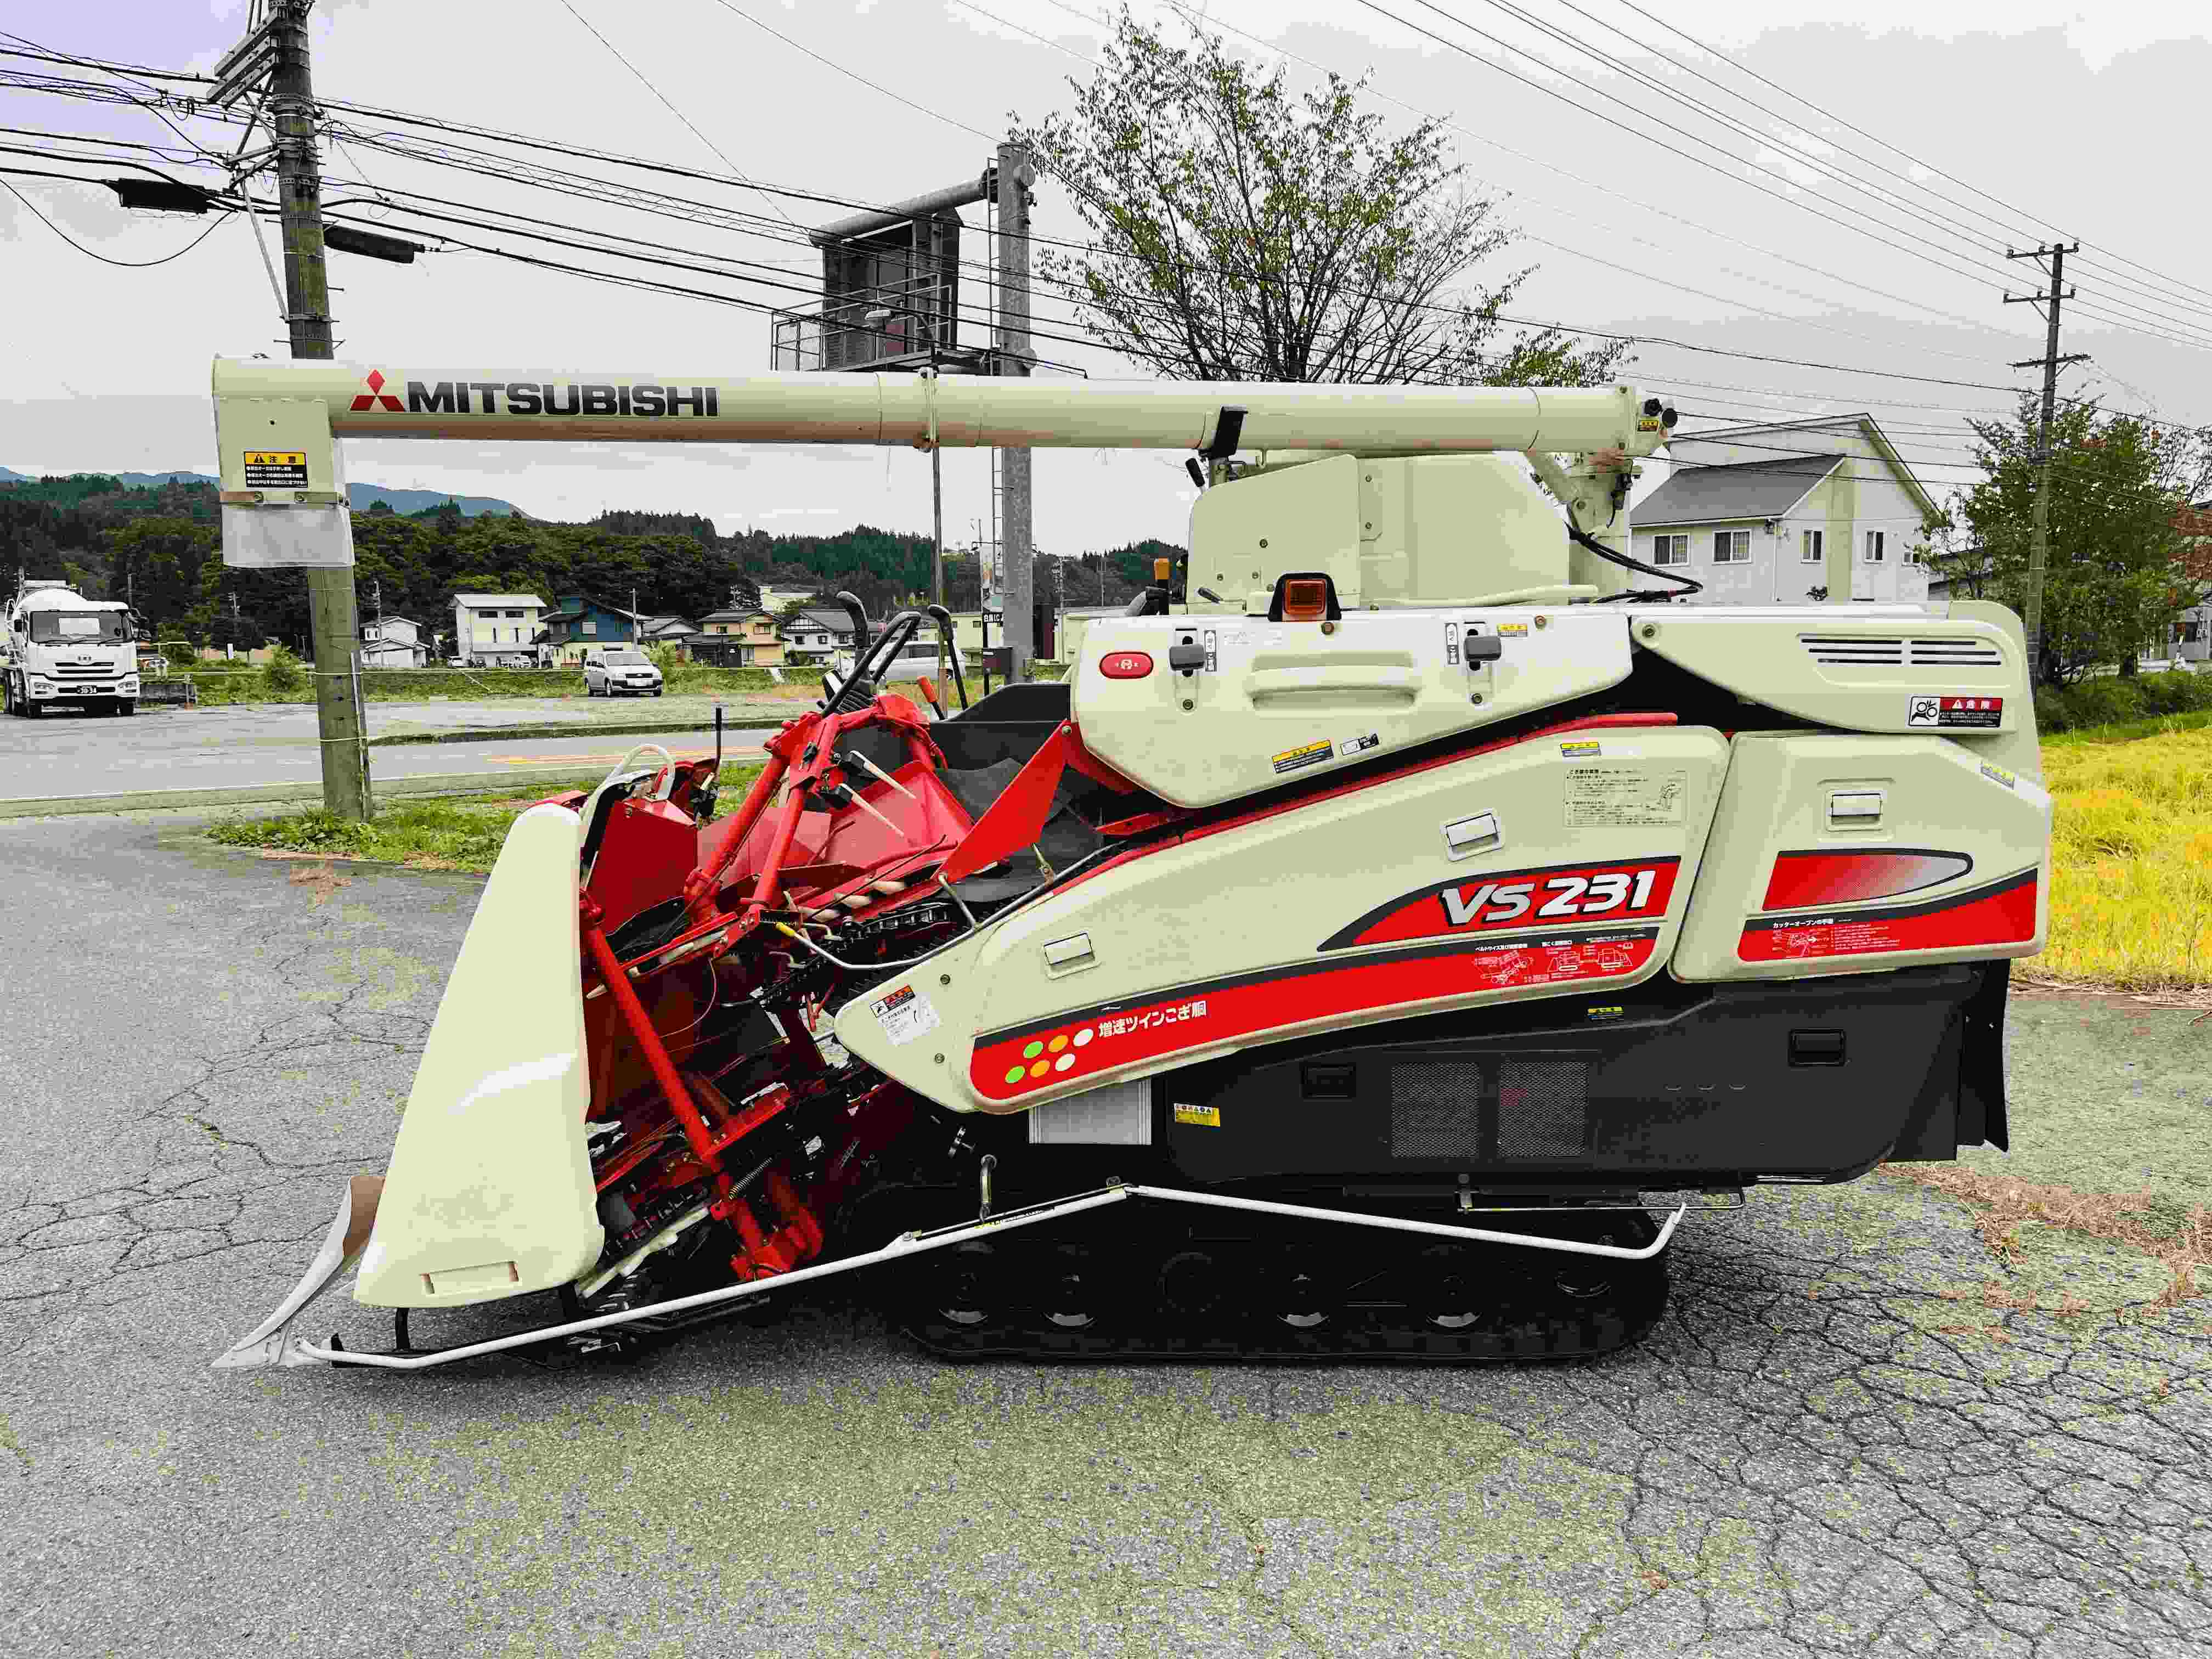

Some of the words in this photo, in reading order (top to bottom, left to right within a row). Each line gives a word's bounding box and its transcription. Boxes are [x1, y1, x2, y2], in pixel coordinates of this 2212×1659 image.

[407, 381, 718, 417] MITSUBISHI
[1441, 883, 1536, 925] VS
[1537, 870, 1656, 918] 231
[1098, 1000, 1207, 1038] 増速ツインこぎ胴
